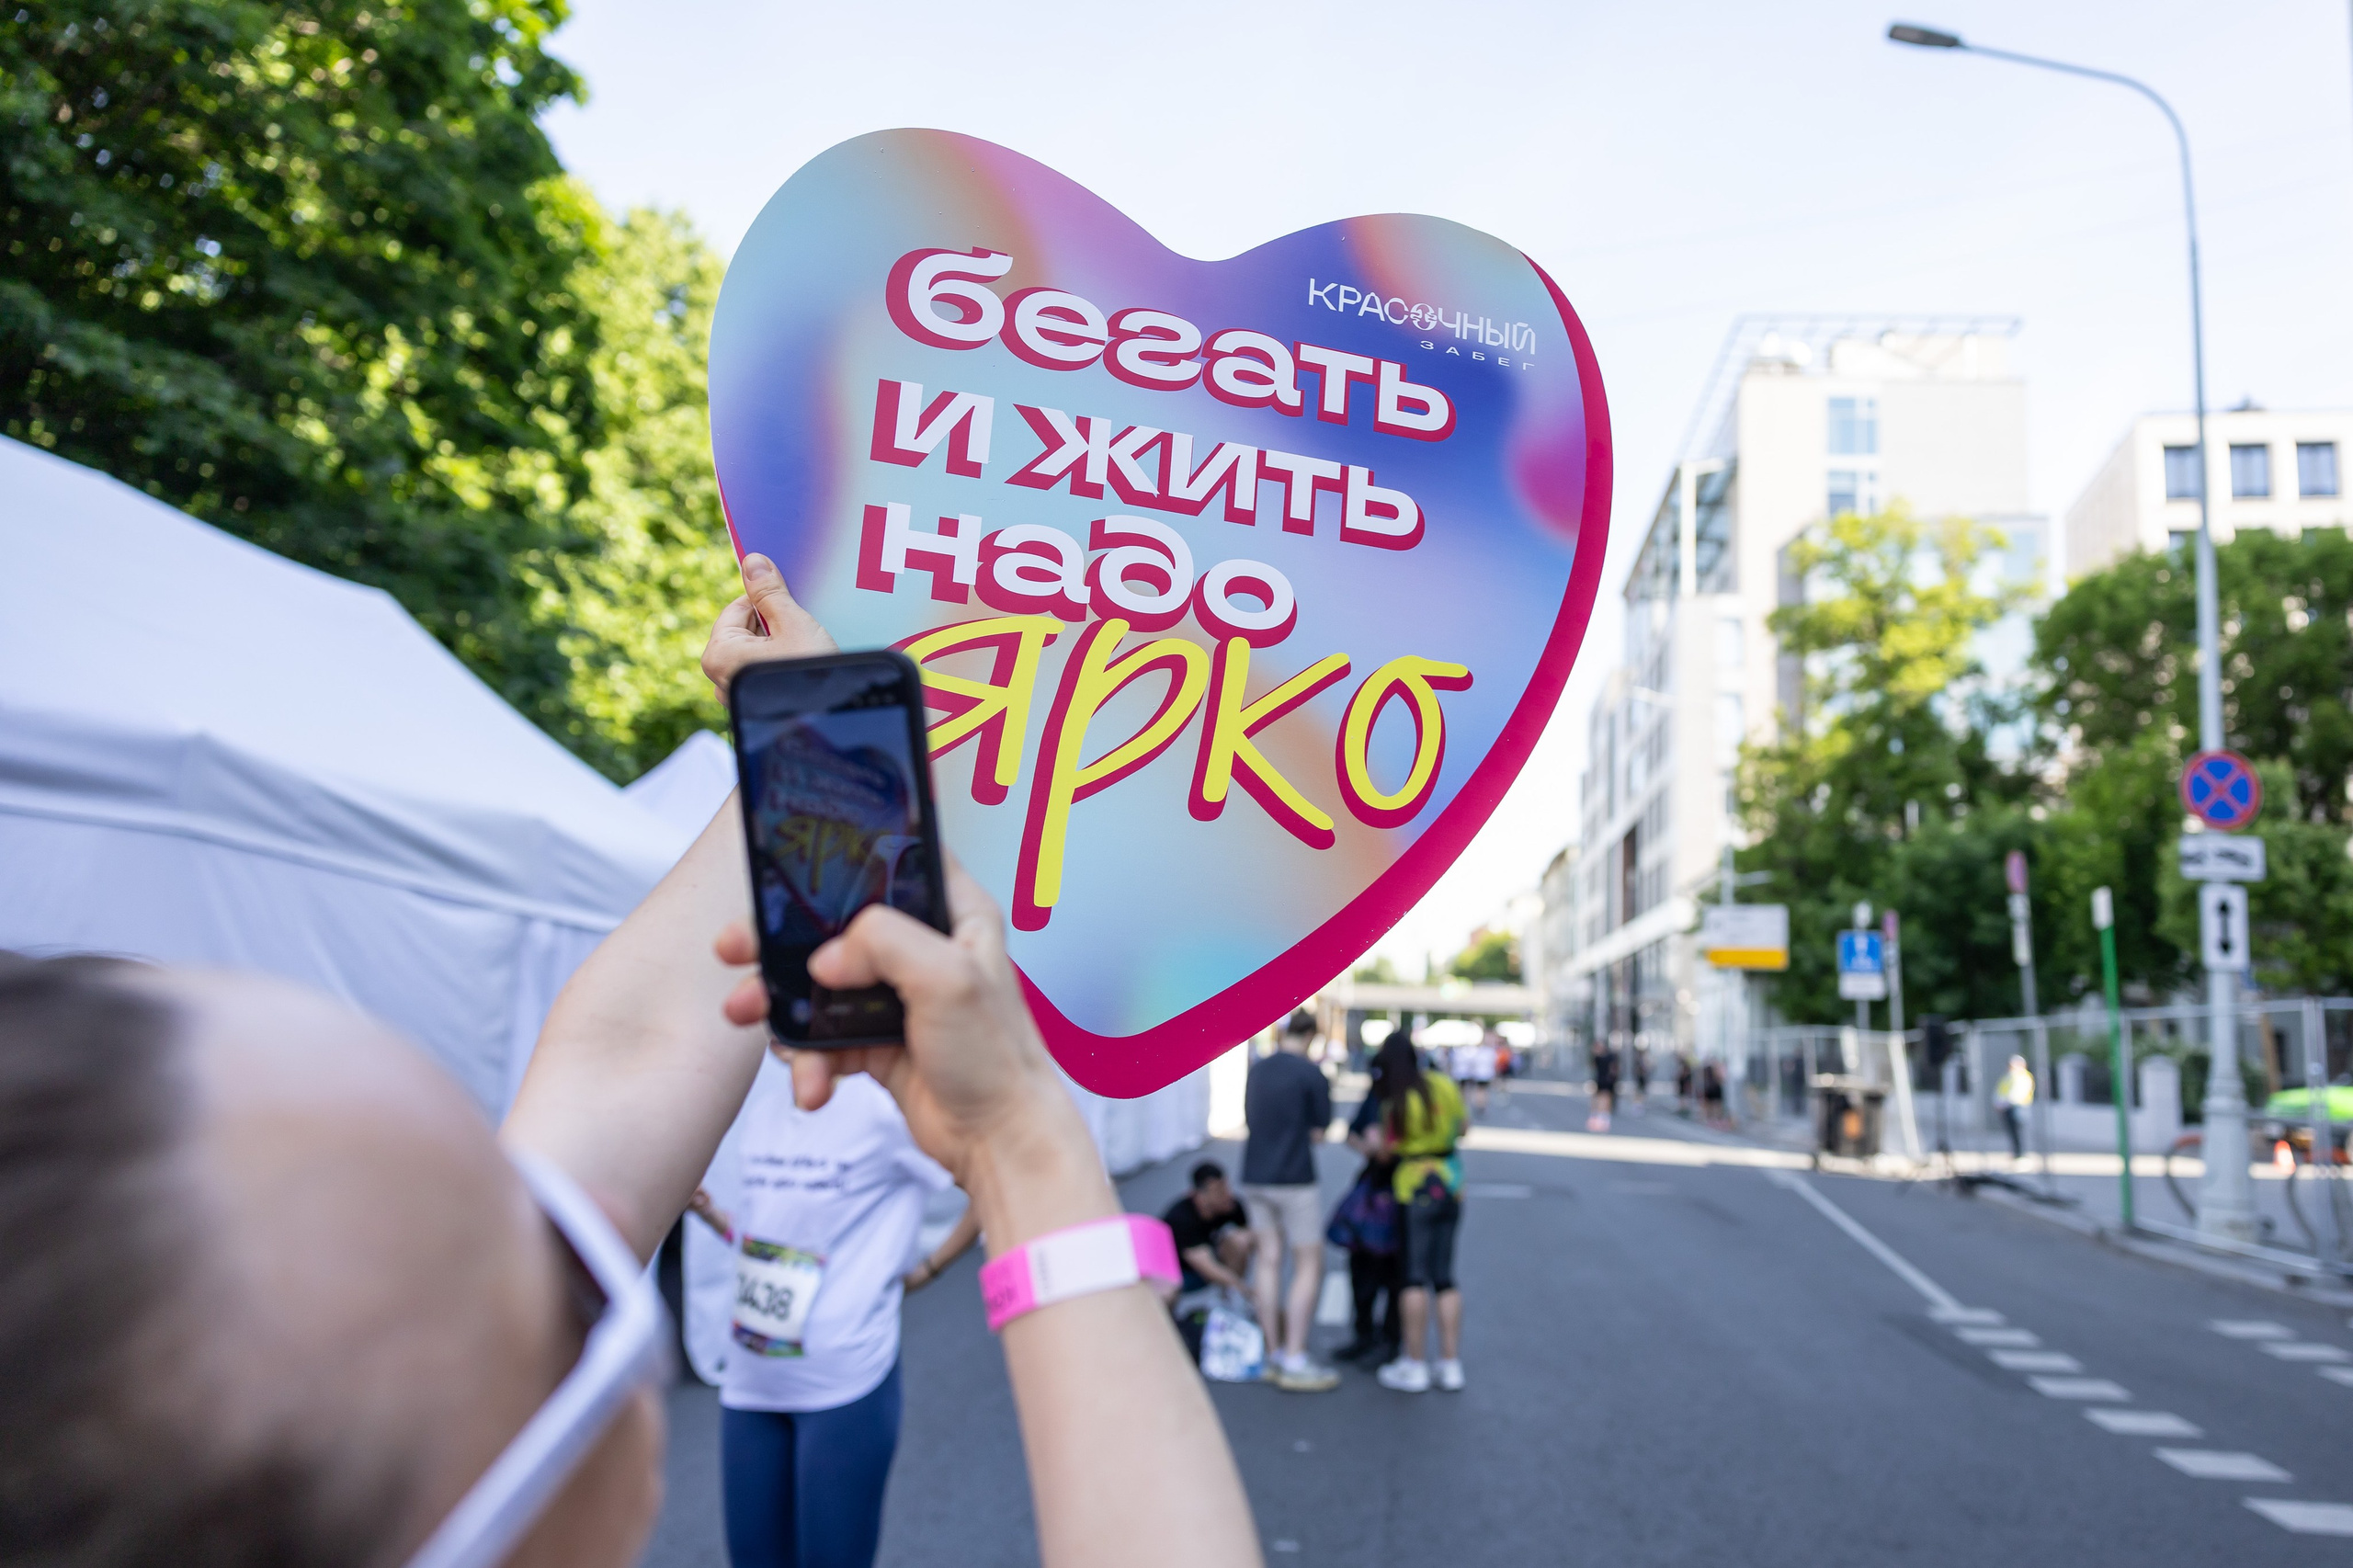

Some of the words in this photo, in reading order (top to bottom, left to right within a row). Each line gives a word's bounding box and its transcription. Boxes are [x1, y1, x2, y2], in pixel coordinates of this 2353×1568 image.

[885, 247, 1457, 441] бегать
[1309, 278, 1536, 355] КРАСОЧНЫЙ
[1420, 340, 1535, 370] ЗАБЕГ
[870, 378, 995, 477] и
[1006, 402, 1426, 551] жить
[855, 504, 1298, 647] надо
